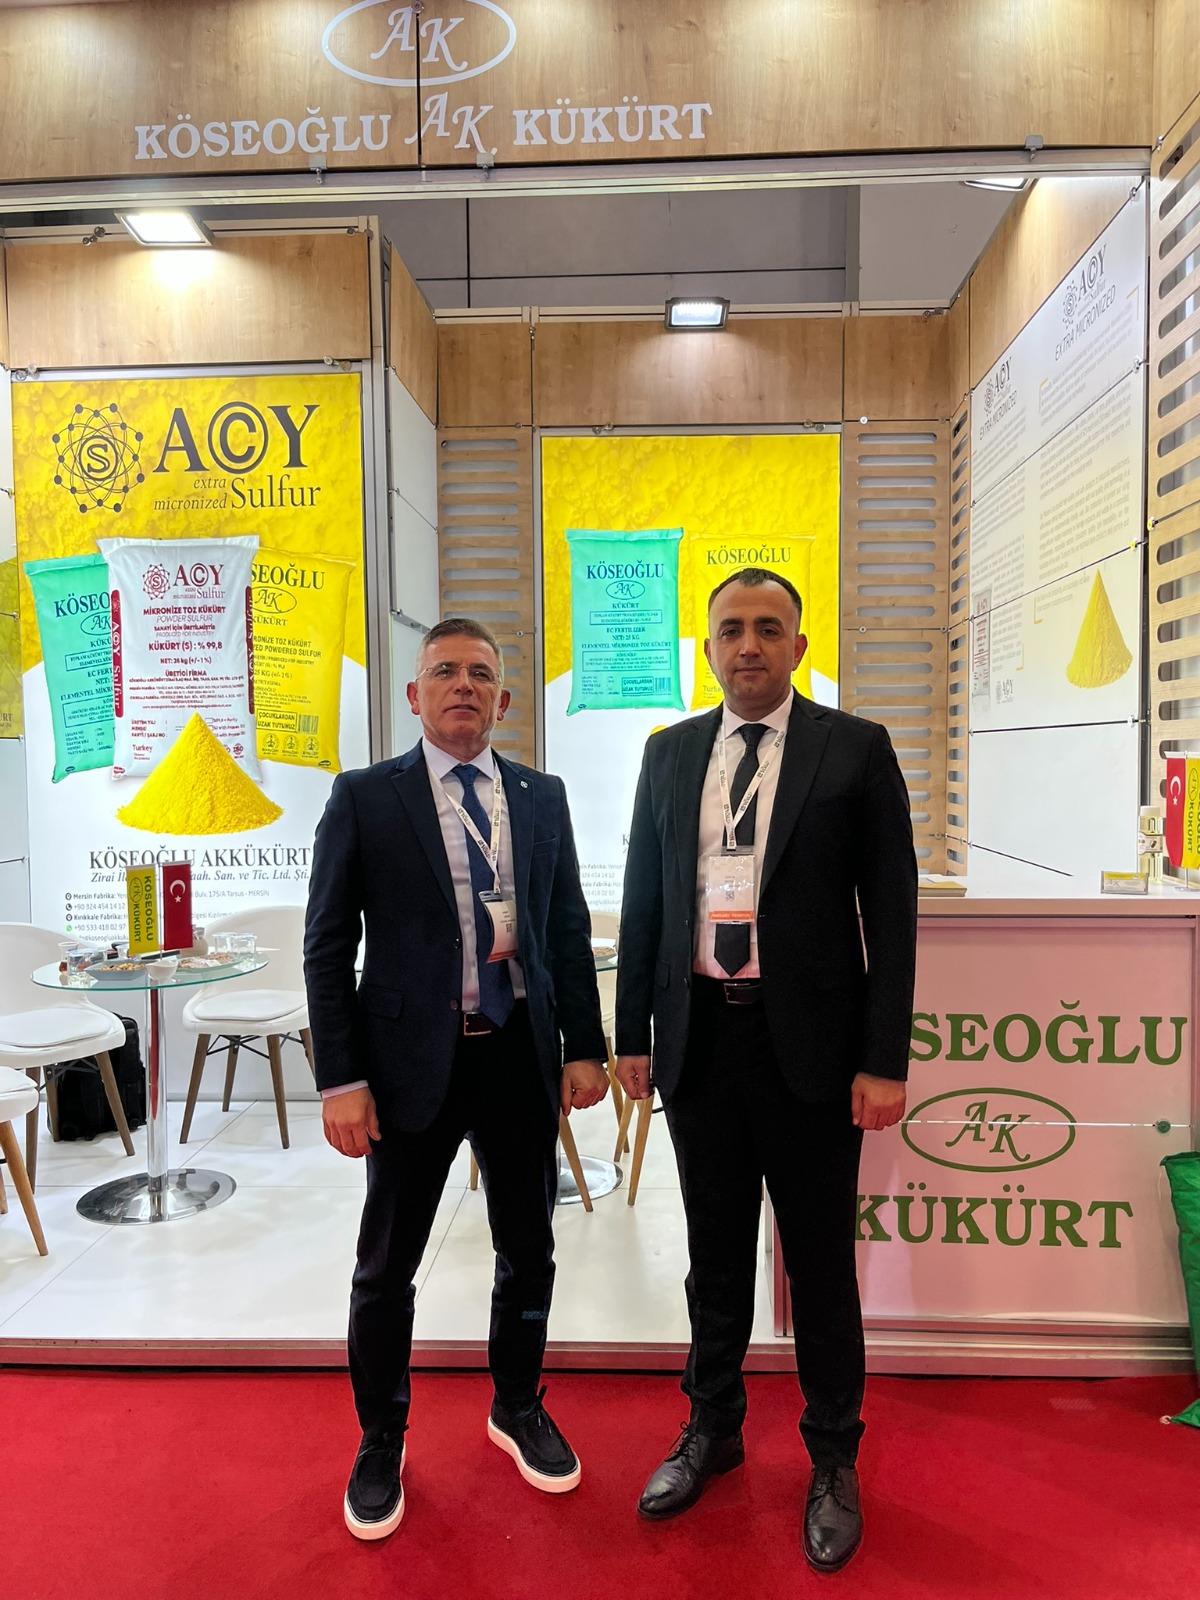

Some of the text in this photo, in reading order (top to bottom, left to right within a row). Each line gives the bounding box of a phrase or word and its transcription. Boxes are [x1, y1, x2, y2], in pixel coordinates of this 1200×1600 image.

[134, 106, 391, 160] KÖSEOĞLU
[513, 95, 712, 146] KÜKÜRT
[1055, 284, 1116, 361] EXTRA MICRONIZED
[193, 477, 227, 490] extra
[153, 473, 321, 511] micronized Sulfur
[706, 544, 792, 565] KÖSEOĞLU
[586, 559, 665, 580] KÖSEOĞLU
[197, 586, 226, 599] Sulfur
[143, 604, 226, 616] MİKRONİZE TOZ KÜKÜRT
[156, 614, 213, 623] POWDER SULFUR
[148, 640, 180, 652] KÜKÜRT
[181, 641, 193, 652] (S)
[206, 641, 223, 652] 99,8
[275, 637, 287, 646] TOZ
[287, 637, 312, 648] KÜKÜRT
[264, 645, 298, 655] POWDERED
[132, 744, 153, 753] Turkey
[200, 843, 311, 867] AKKÜKÜRT
[91, 870, 115, 882] Zirai
[213, 869, 236, 881] San.
[238, 871, 250, 880] ve
[252, 869, 269, 880] Tic.
[272, 868, 291, 880] Ltd.
[293, 868, 310, 881] Şti.
[73, 892, 93, 900] Mersin
[93, 891, 117, 900] Fabrika:
[226, 889, 245, 897] Tarsus
[248, 887, 270, 897] MERSİN
[86, 902, 96, 910] 324
[96, 902, 108, 910] 454
[100, 911, 123, 921] Fabrika:
[86, 923, 98, 931] 533
[109, 923, 118, 931] 02
[944, 1100, 1031, 1163] AK
[855, 1181, 1134, 1249] KÜKÜRT
